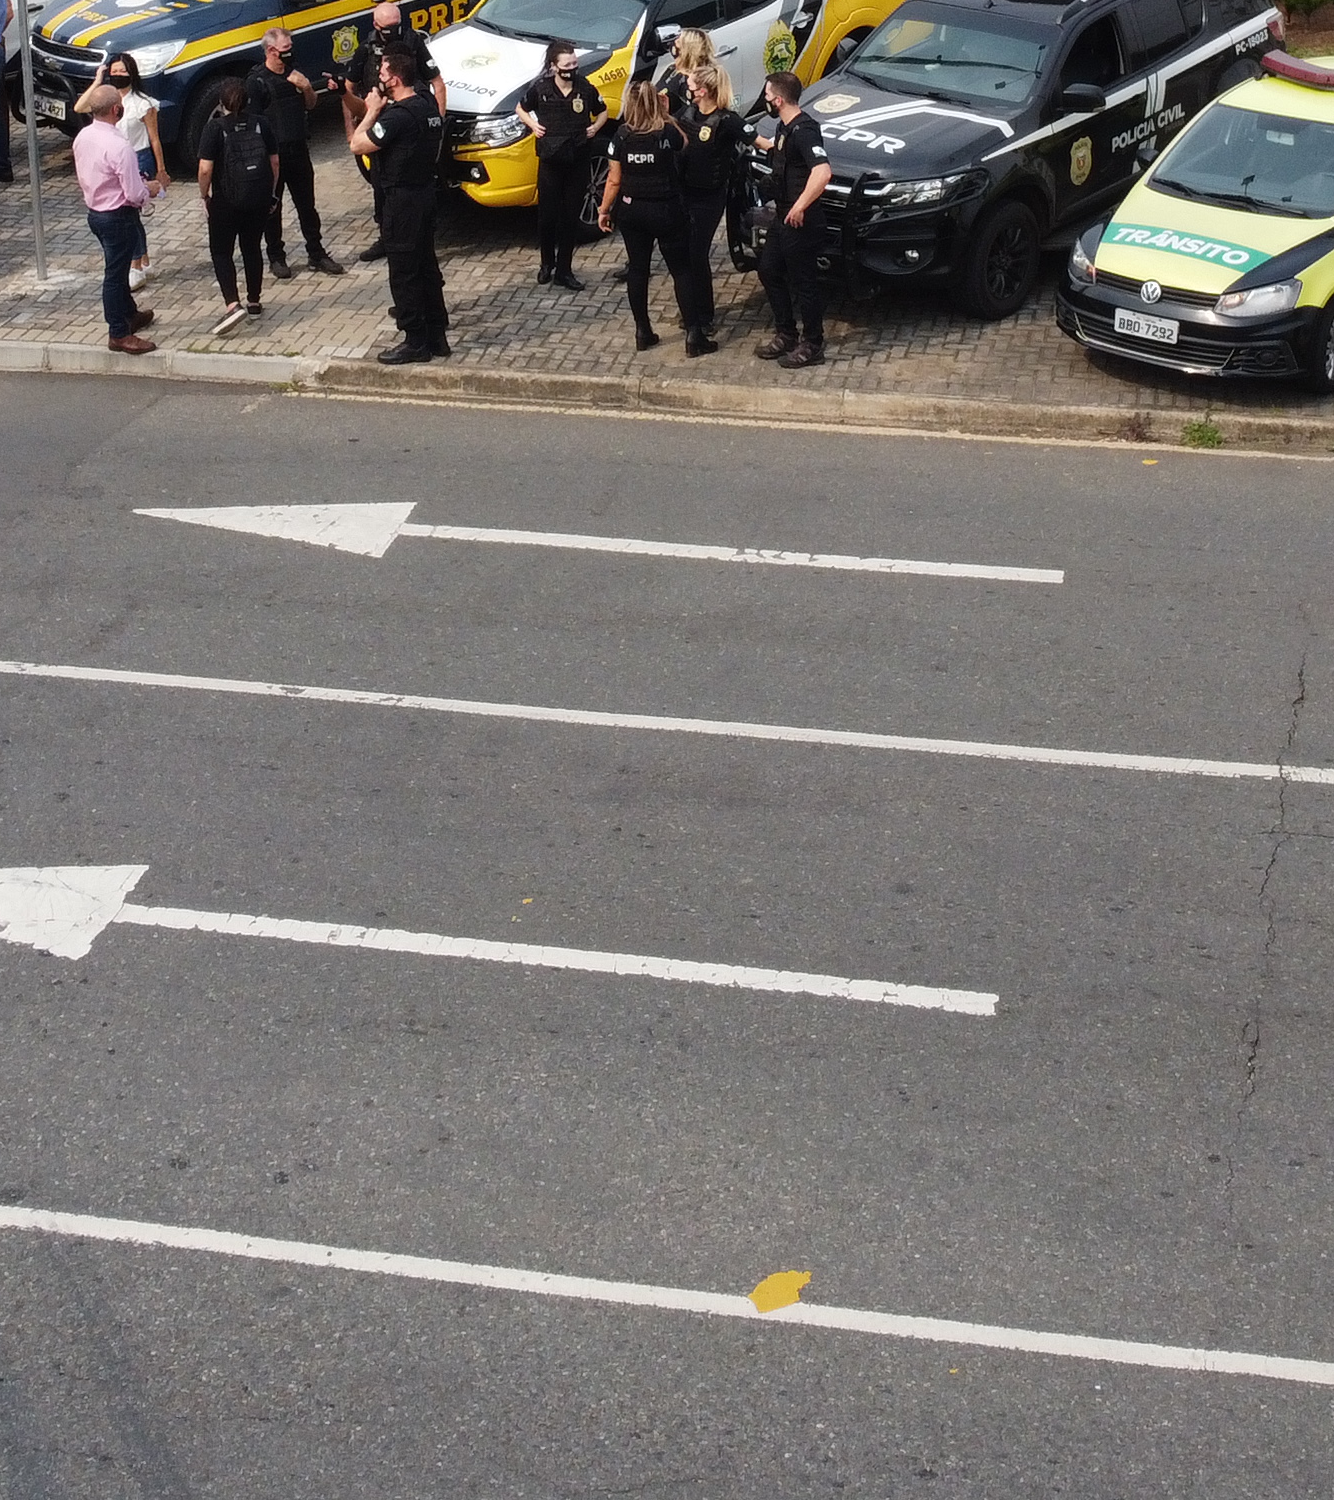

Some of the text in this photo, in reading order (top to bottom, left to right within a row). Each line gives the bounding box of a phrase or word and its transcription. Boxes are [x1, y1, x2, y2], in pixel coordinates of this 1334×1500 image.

[1157, 103, 1185, 128] CIVIL
[820, 123, 906, 154] CPR
[627, 153, 655, 164] PCPR
[1112, 227, 1250, 265] TRÂNSITO
